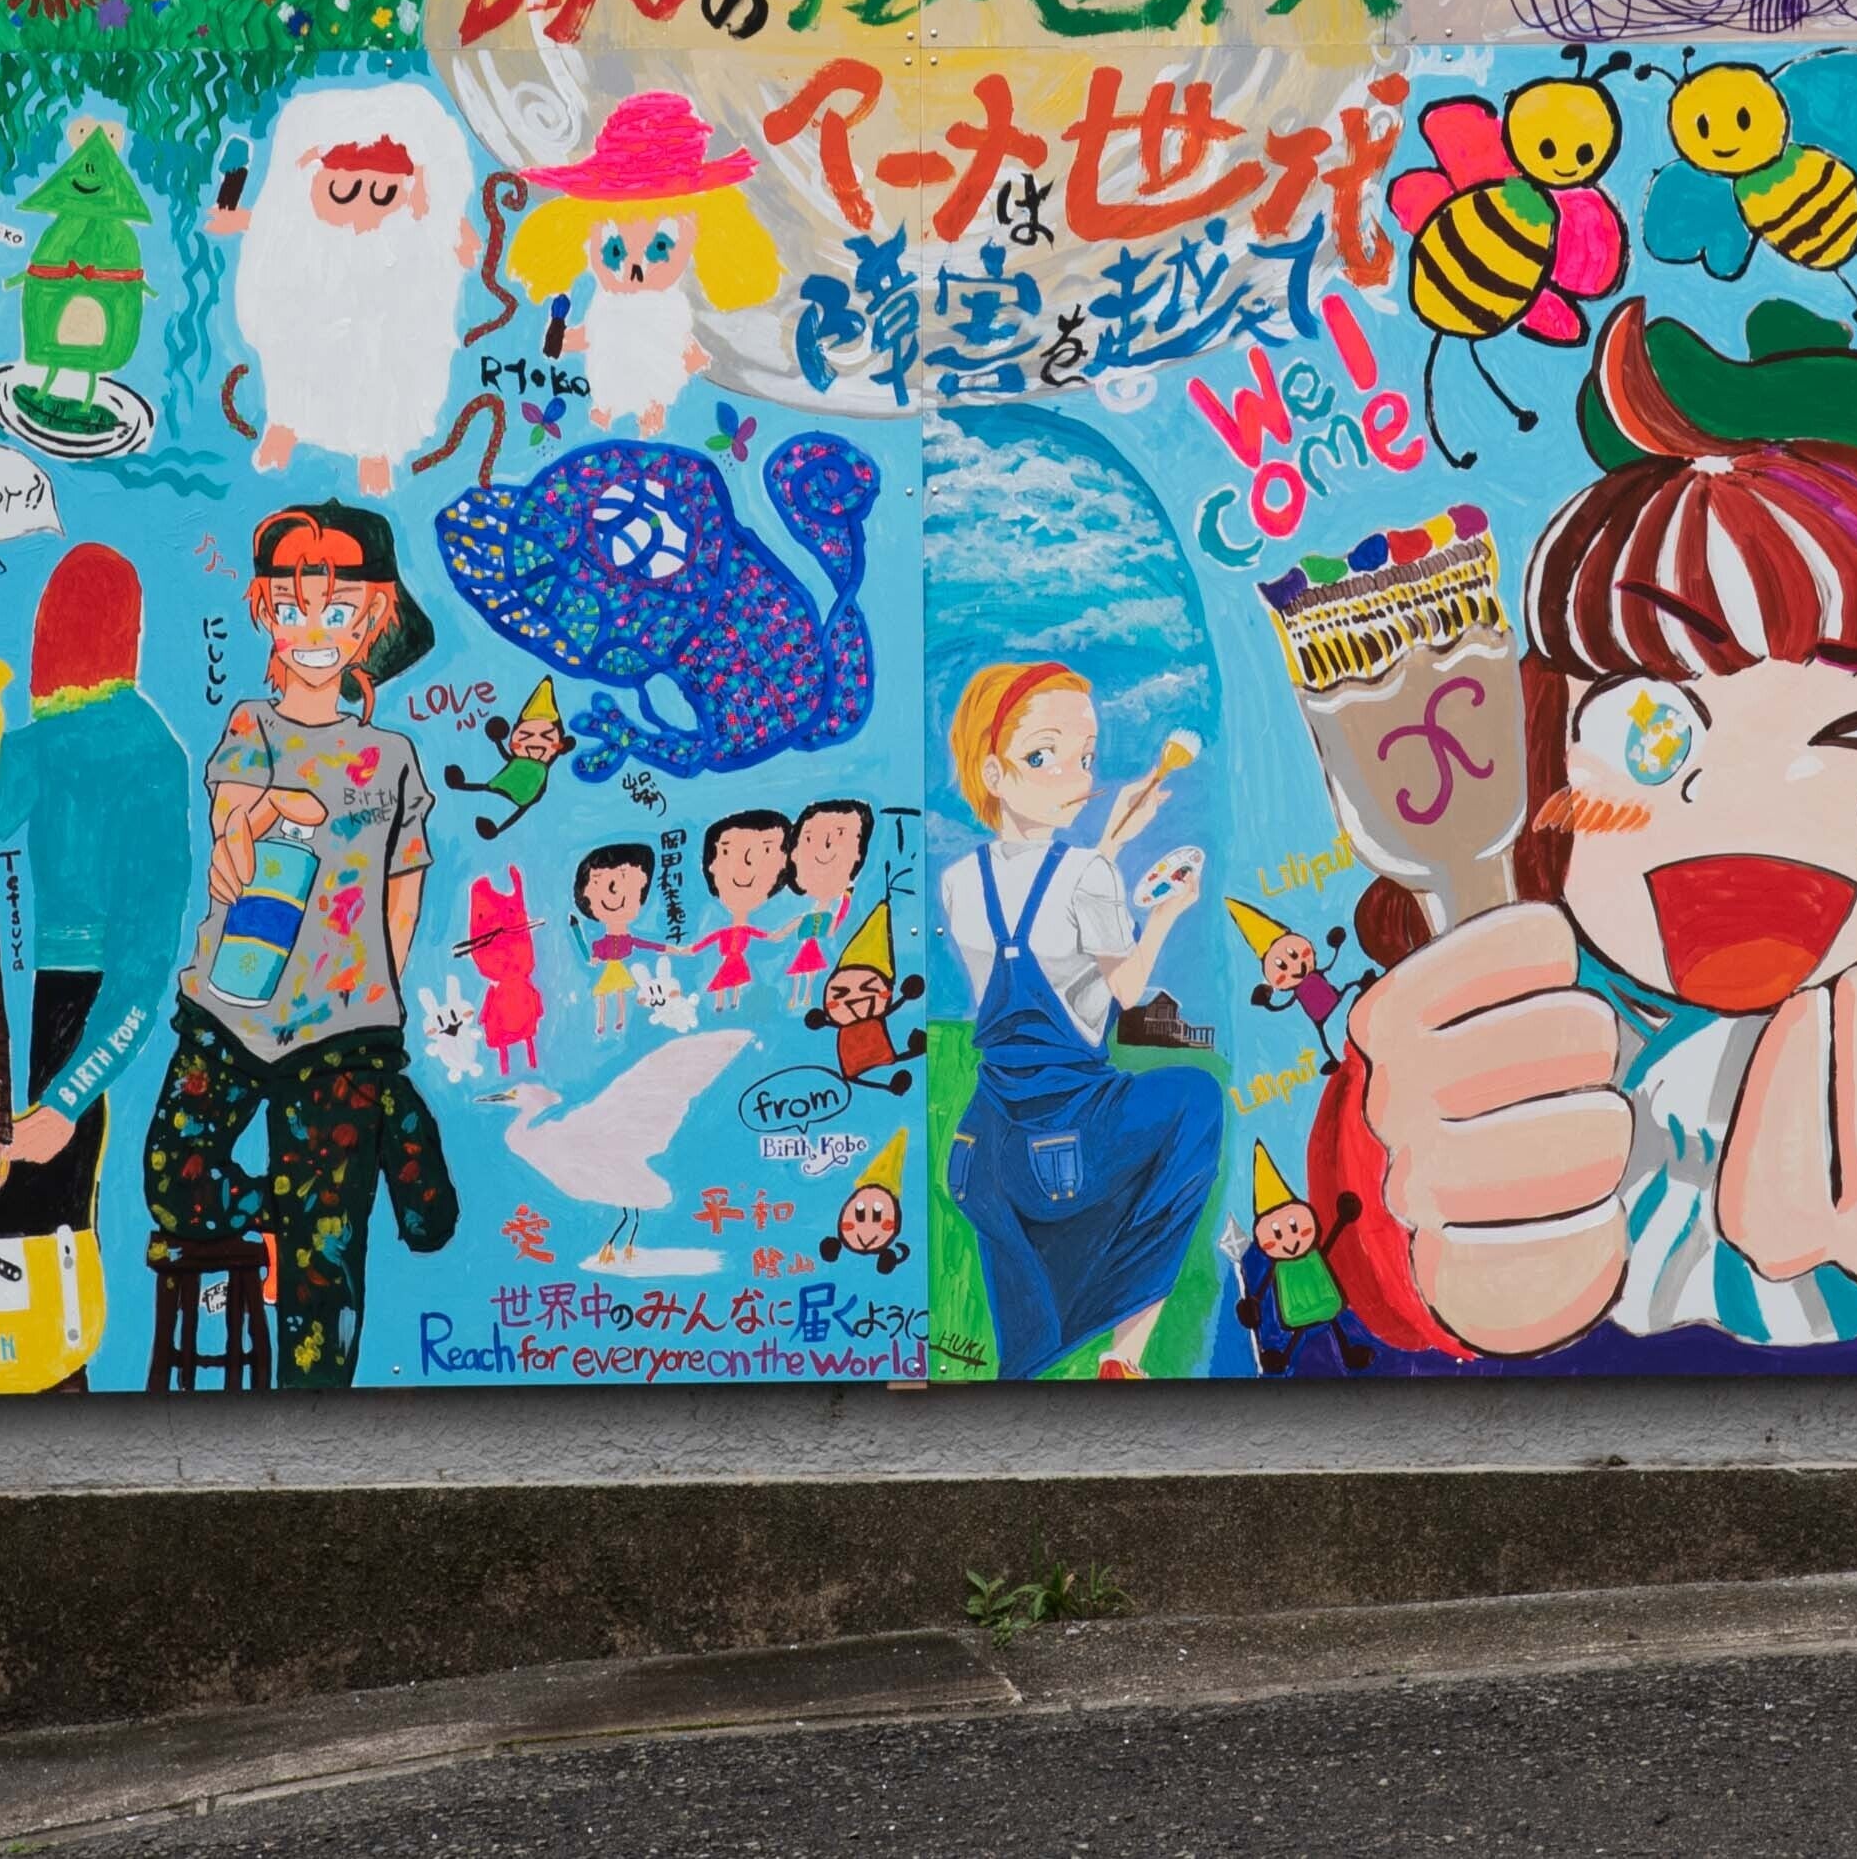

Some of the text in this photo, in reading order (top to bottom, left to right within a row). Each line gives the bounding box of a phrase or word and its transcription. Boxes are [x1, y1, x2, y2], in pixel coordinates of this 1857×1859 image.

[753, 1088, 840, 1123] from
[501, 1203, 556, 1265] 愛
[693, 1187, 796, 1235] 平和
[490, 1281, 930, 1344] 世界中のみんなに届くように
[420, 1312, 516, 1377] Reach
[517, 1335, 569, 1374] for
[572, 1346, 705, 1383] everyone
[706, 1348, 751, 1378] on
[752, 1336, 806, 1377] the
